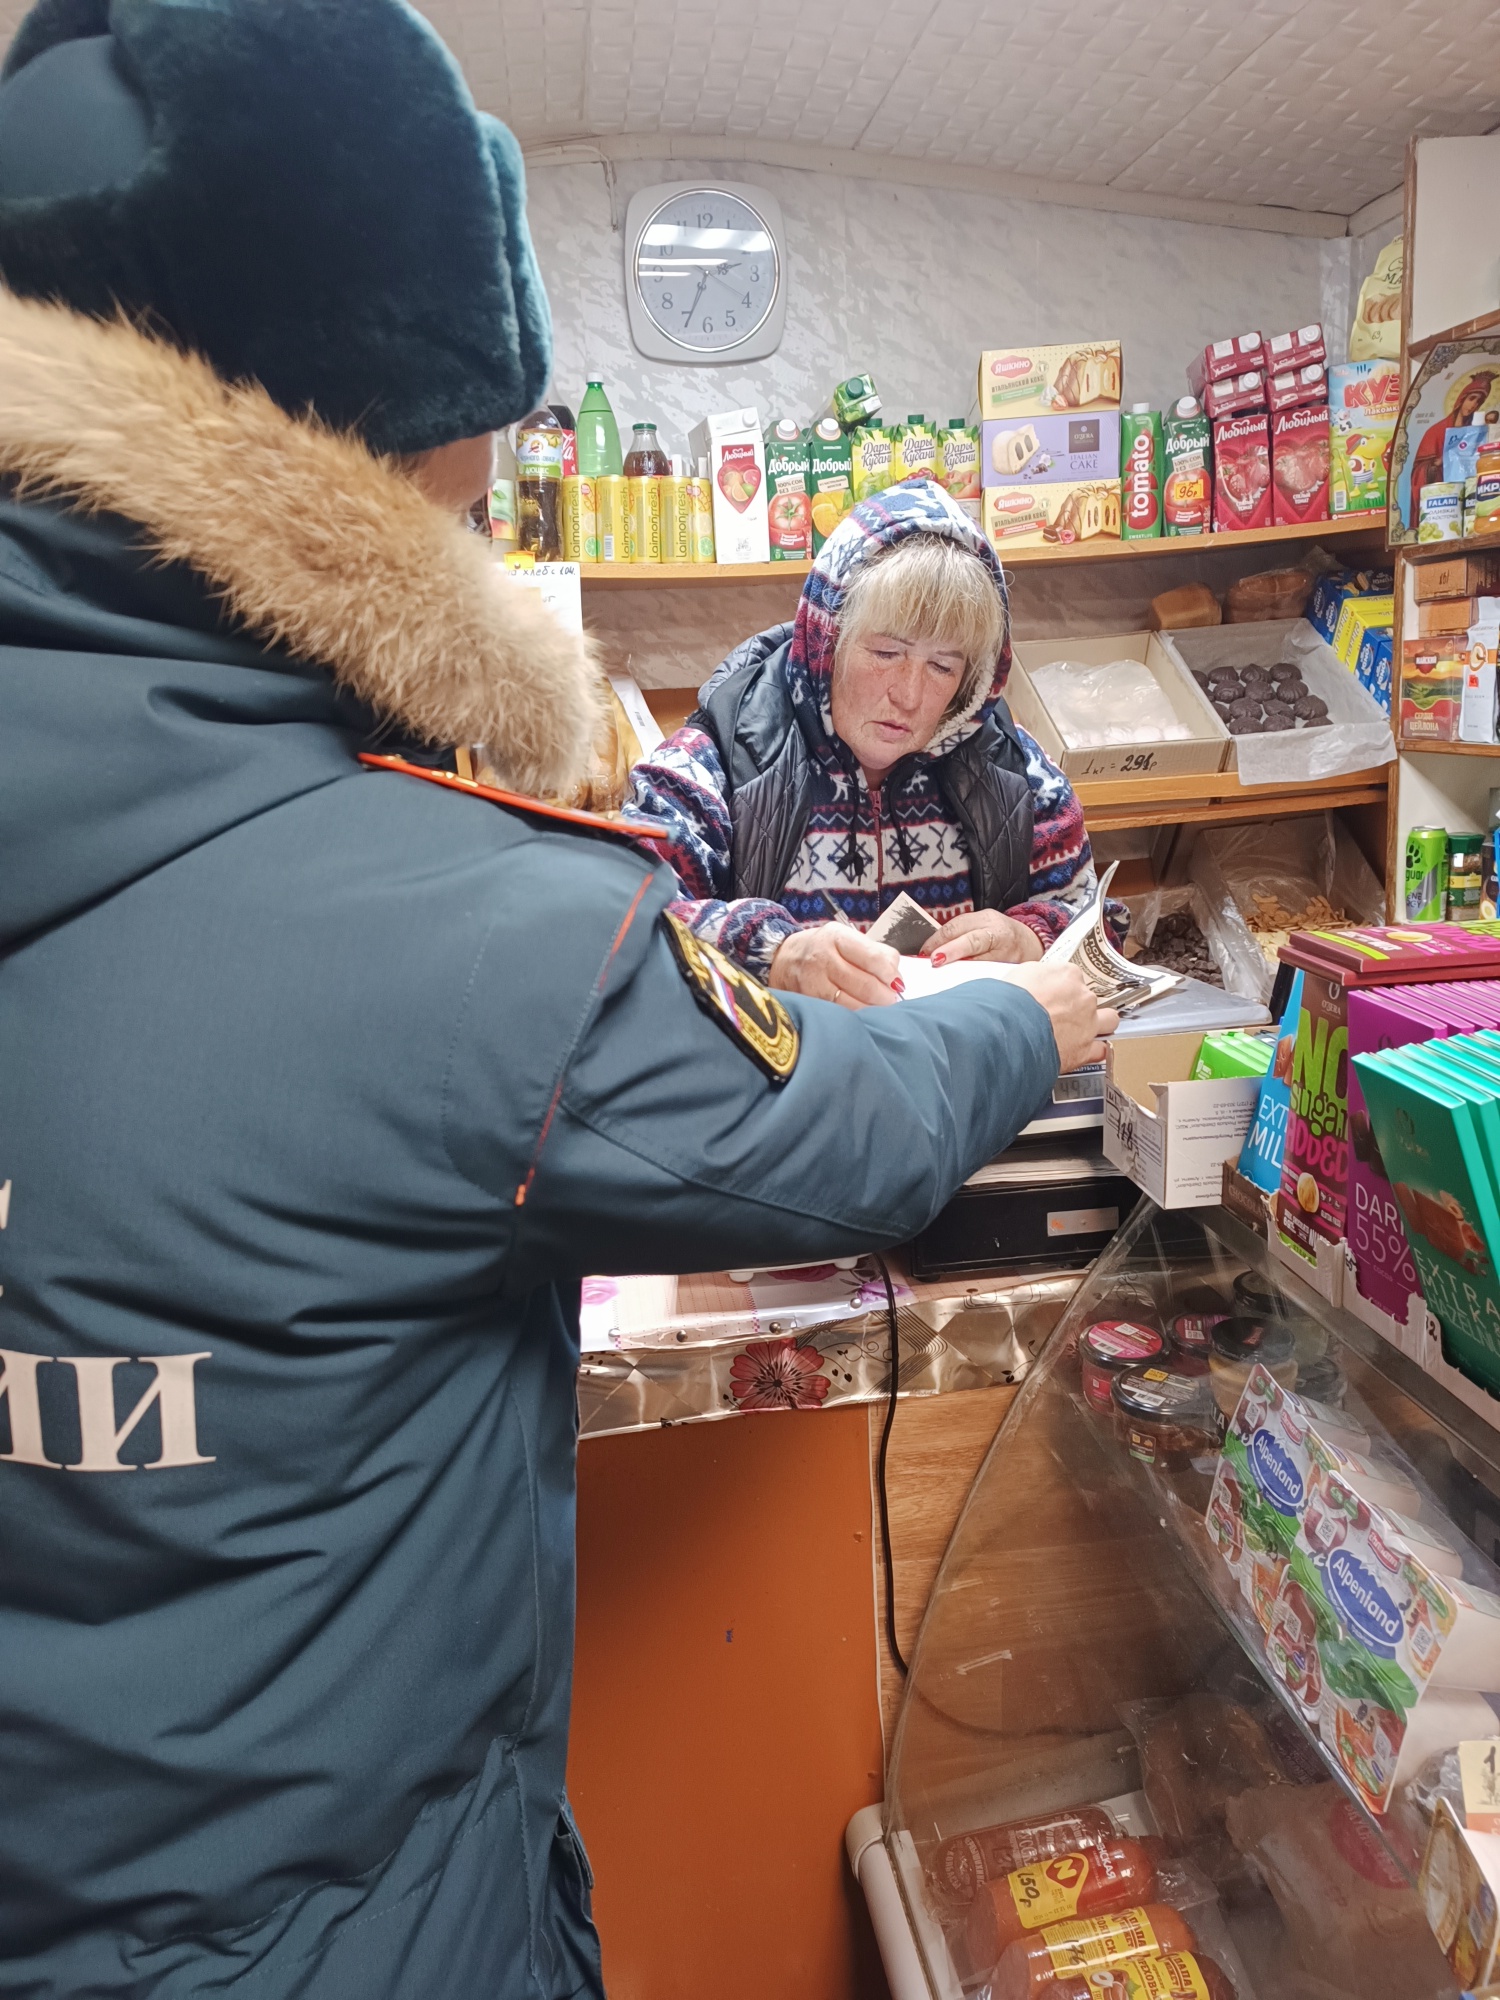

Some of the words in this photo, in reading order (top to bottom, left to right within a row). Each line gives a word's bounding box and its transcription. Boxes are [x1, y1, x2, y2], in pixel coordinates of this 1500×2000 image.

[697, 213, 713, 229] 12
[653, 265, 664, 283] 9
[750, 265, 760, 283] 3
[661, 292, 673, 309] 8
[741, 291, 752, 309] 4
[681, 311, 691, 328] 7
[702, 316, 714, 333] 6
[725, 310, 736, 327] 5
[994, 361, 1030, 374] Яшкино
[1275, 409, 1328, 435] Любимый
[1216, 419, 1267, 444] Любимый
[863, 442, 891, 454] Дары
[904, 438, 933, 450] Дары
[944, 442, 973, 454] Дары
[1165, 437, 1210, 454] Добрый
[768, 458, 810, 476] Добрый
[812, 458, 852, 475] Добрый
[902, 449, 935, 467] Кубани
[943, 453, 976, 471] Кубани
[1070, 460, 1098, 470] CAKE
[1131, 434, 1149, 518] tomato
[998, 497, 1033, 510] Яшкино
[1428, 498, 1457, 507] FALANI
[569, 485, 580, 559] Laimonfresh
[621, 486, 630, 559] Laimonfresh
[648, 487, 658, 559] Laimonfresh
[676, 486, 686, 559] Laimonfresh
[1328, 601, 1337, 630] TONDI
[1362, 643, 1371, 671] TONDI
[1377, 657, 1387, 686] TONDI
[1409, 721, 1439, 731] ЦЕЙЛОНА
[1088, 938, 1145, 982] ПОЖАРНОЙ
[1355, 1183, 1404, 1236] DAR
[1356, 1213, 1416, 1282] 55%
[1420, 1269, 1482, 1325] MILK
[1255, 1436, 1300, 1498] Alpenland
[1369, 1532, 1400, 1569] Ehrmann
[1332, 1558, 1400, 1638] Alpenland
[1131, 1916, 1147, 1947] ПАПА
[1164, 1961, 1179, 1987] МОЖЕТ
[1174, 1957, 1193, 1987] ПАПА
